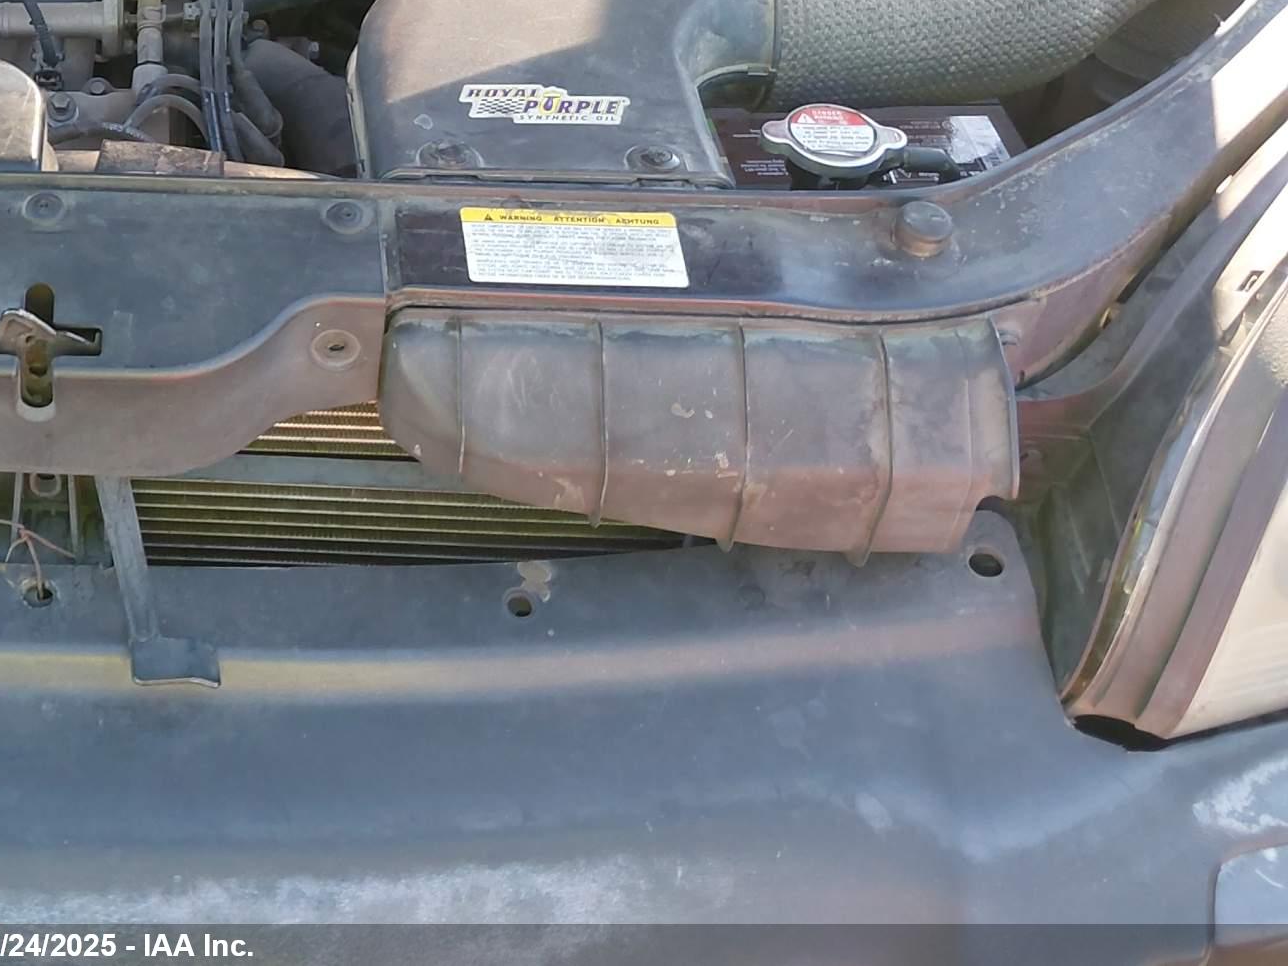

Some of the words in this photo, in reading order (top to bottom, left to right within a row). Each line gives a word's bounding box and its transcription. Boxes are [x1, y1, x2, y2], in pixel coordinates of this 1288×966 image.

[466, 88, 538, 98] ROYAL
[523, 96, 619, 114] PURPLE
[499, 214, 543, 222] WARNING
[553, 215, 605, 224] ATTENTION
